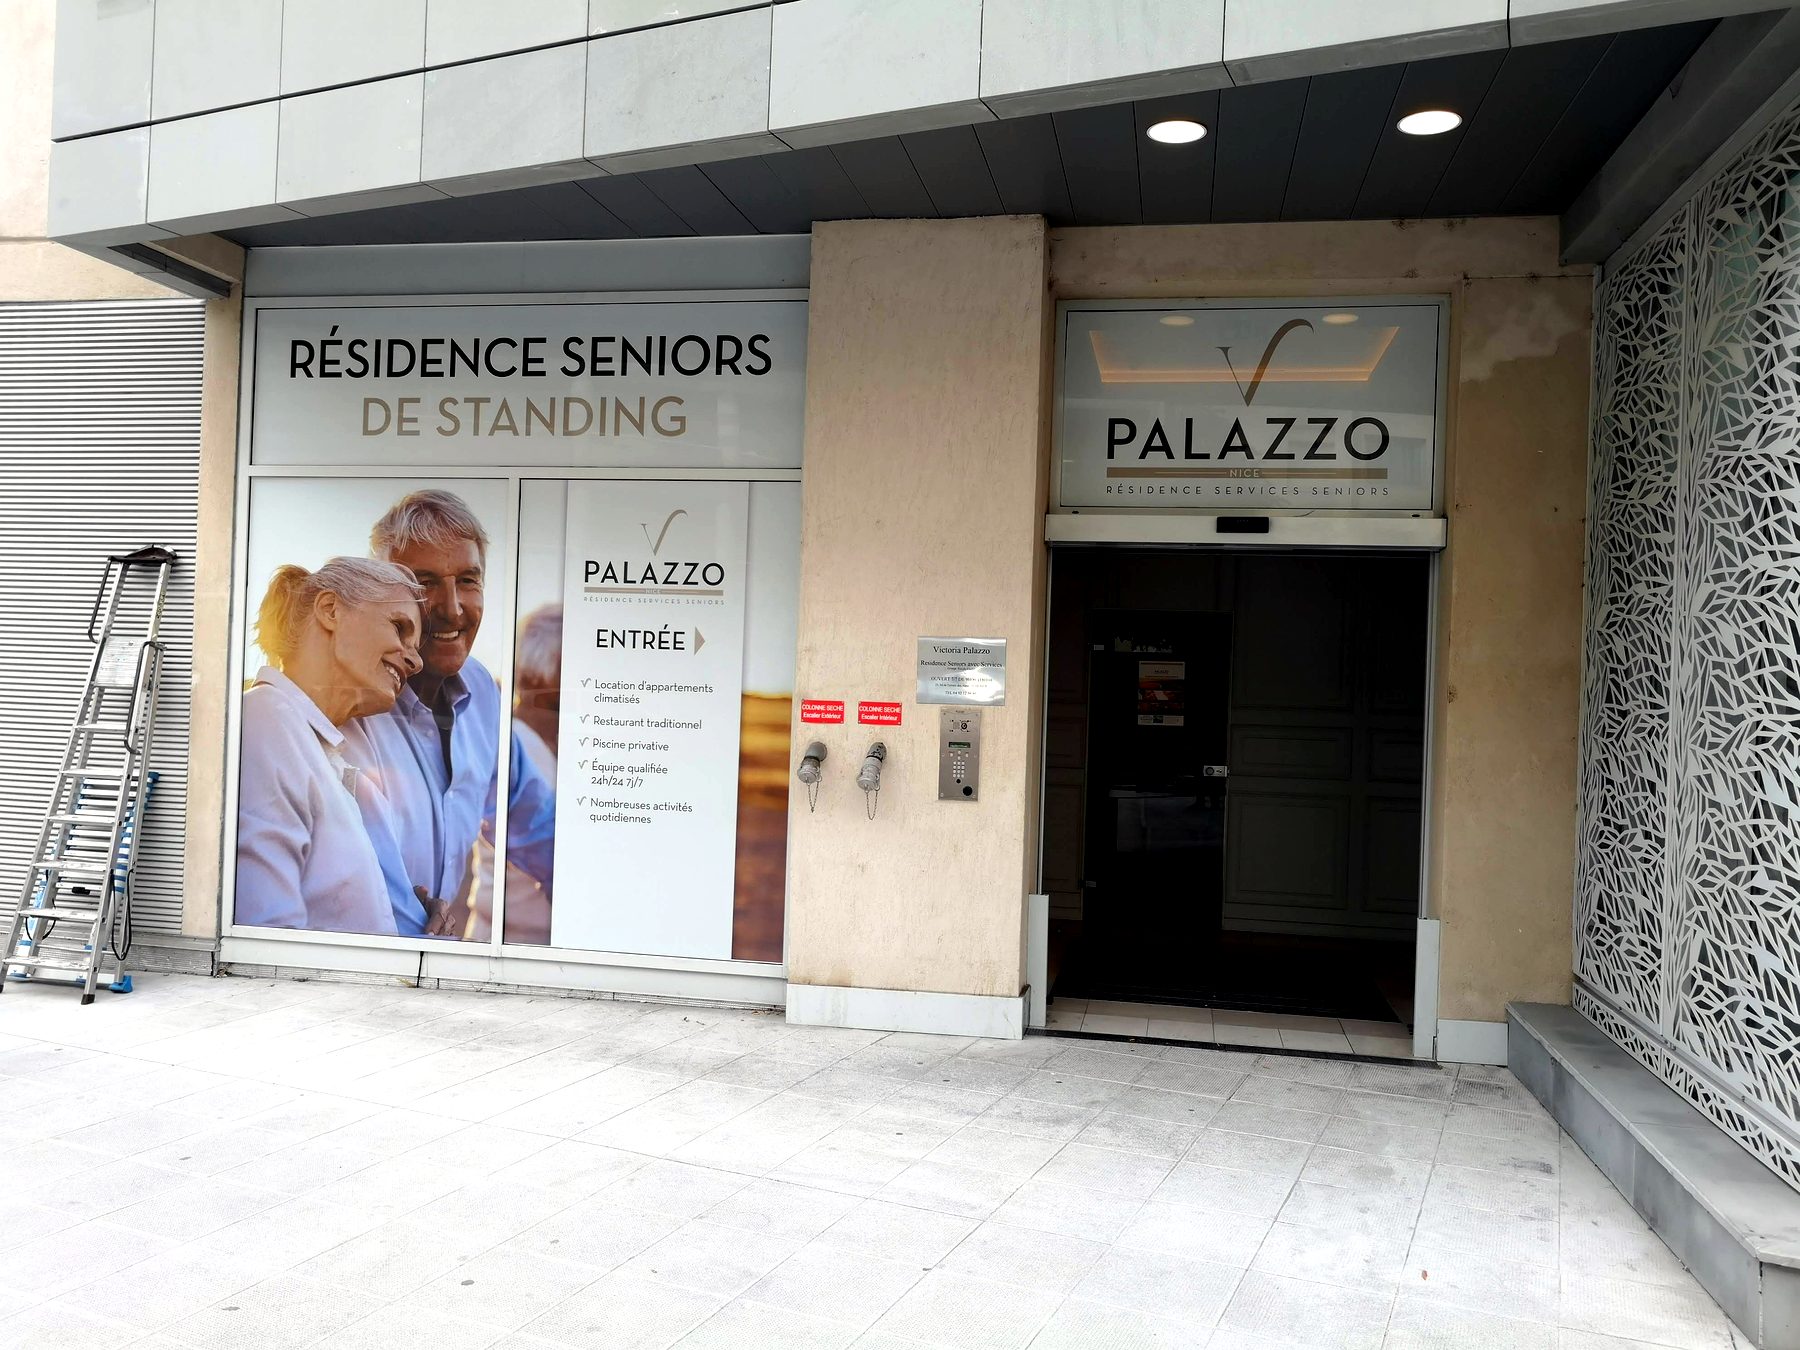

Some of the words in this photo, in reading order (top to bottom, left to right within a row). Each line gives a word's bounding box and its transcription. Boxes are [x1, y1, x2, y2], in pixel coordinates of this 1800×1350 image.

[289, 325, 547, 379] RÉSIDENCE
[560, 333, 773, 377] SENIORS
[362, 396, 421, 437] DE
[436, 396, 687, 437] STANDING
[1106, 416, 1390, 461] PALAZZO
[1229, 469, 1260, 478] NICE
[1106, 483, 1202, 495] RÉSIDENCE
[1214, 486, 1300, 496] SERVICES
[1312, 486, 1389, 497] SENIORS
[584, 560, 725, 586] PALAZZO
[638, 597, 681, 605] SERVICES
[686, 598, 725, 606] SENIORS
[596, 624, 685, 651] ENTRÉE
[933, 646, 961, 654] Victoria
[963, 646, 990, 655] Palazzo
[594, 679, 636, 691] Location
[637, 680, 714, 694] d'appartements
[594, 692, 641, 705] climatisés
[803, 711, 821, 719] Escalier
[858, 705, 883, 713] COLONNE
[593, 715, 645, 728] Restaurant
[646, 718, 702, 730] traditionnel
[592, 738, 626, 750] Piscine
[628, 740, 669, 752] privative
[591, 758, 625, 774] Équipe
[627, 762, 668, 775] qualifiée
[591, 775, 624, 787] 24h/24
[626, 777, 644, 789] 7j/7
[590, 797, 651, 811] Nombreuses
[652, 800, 693, 813] activités
[589, 812, 652, 824] quotidiennes
